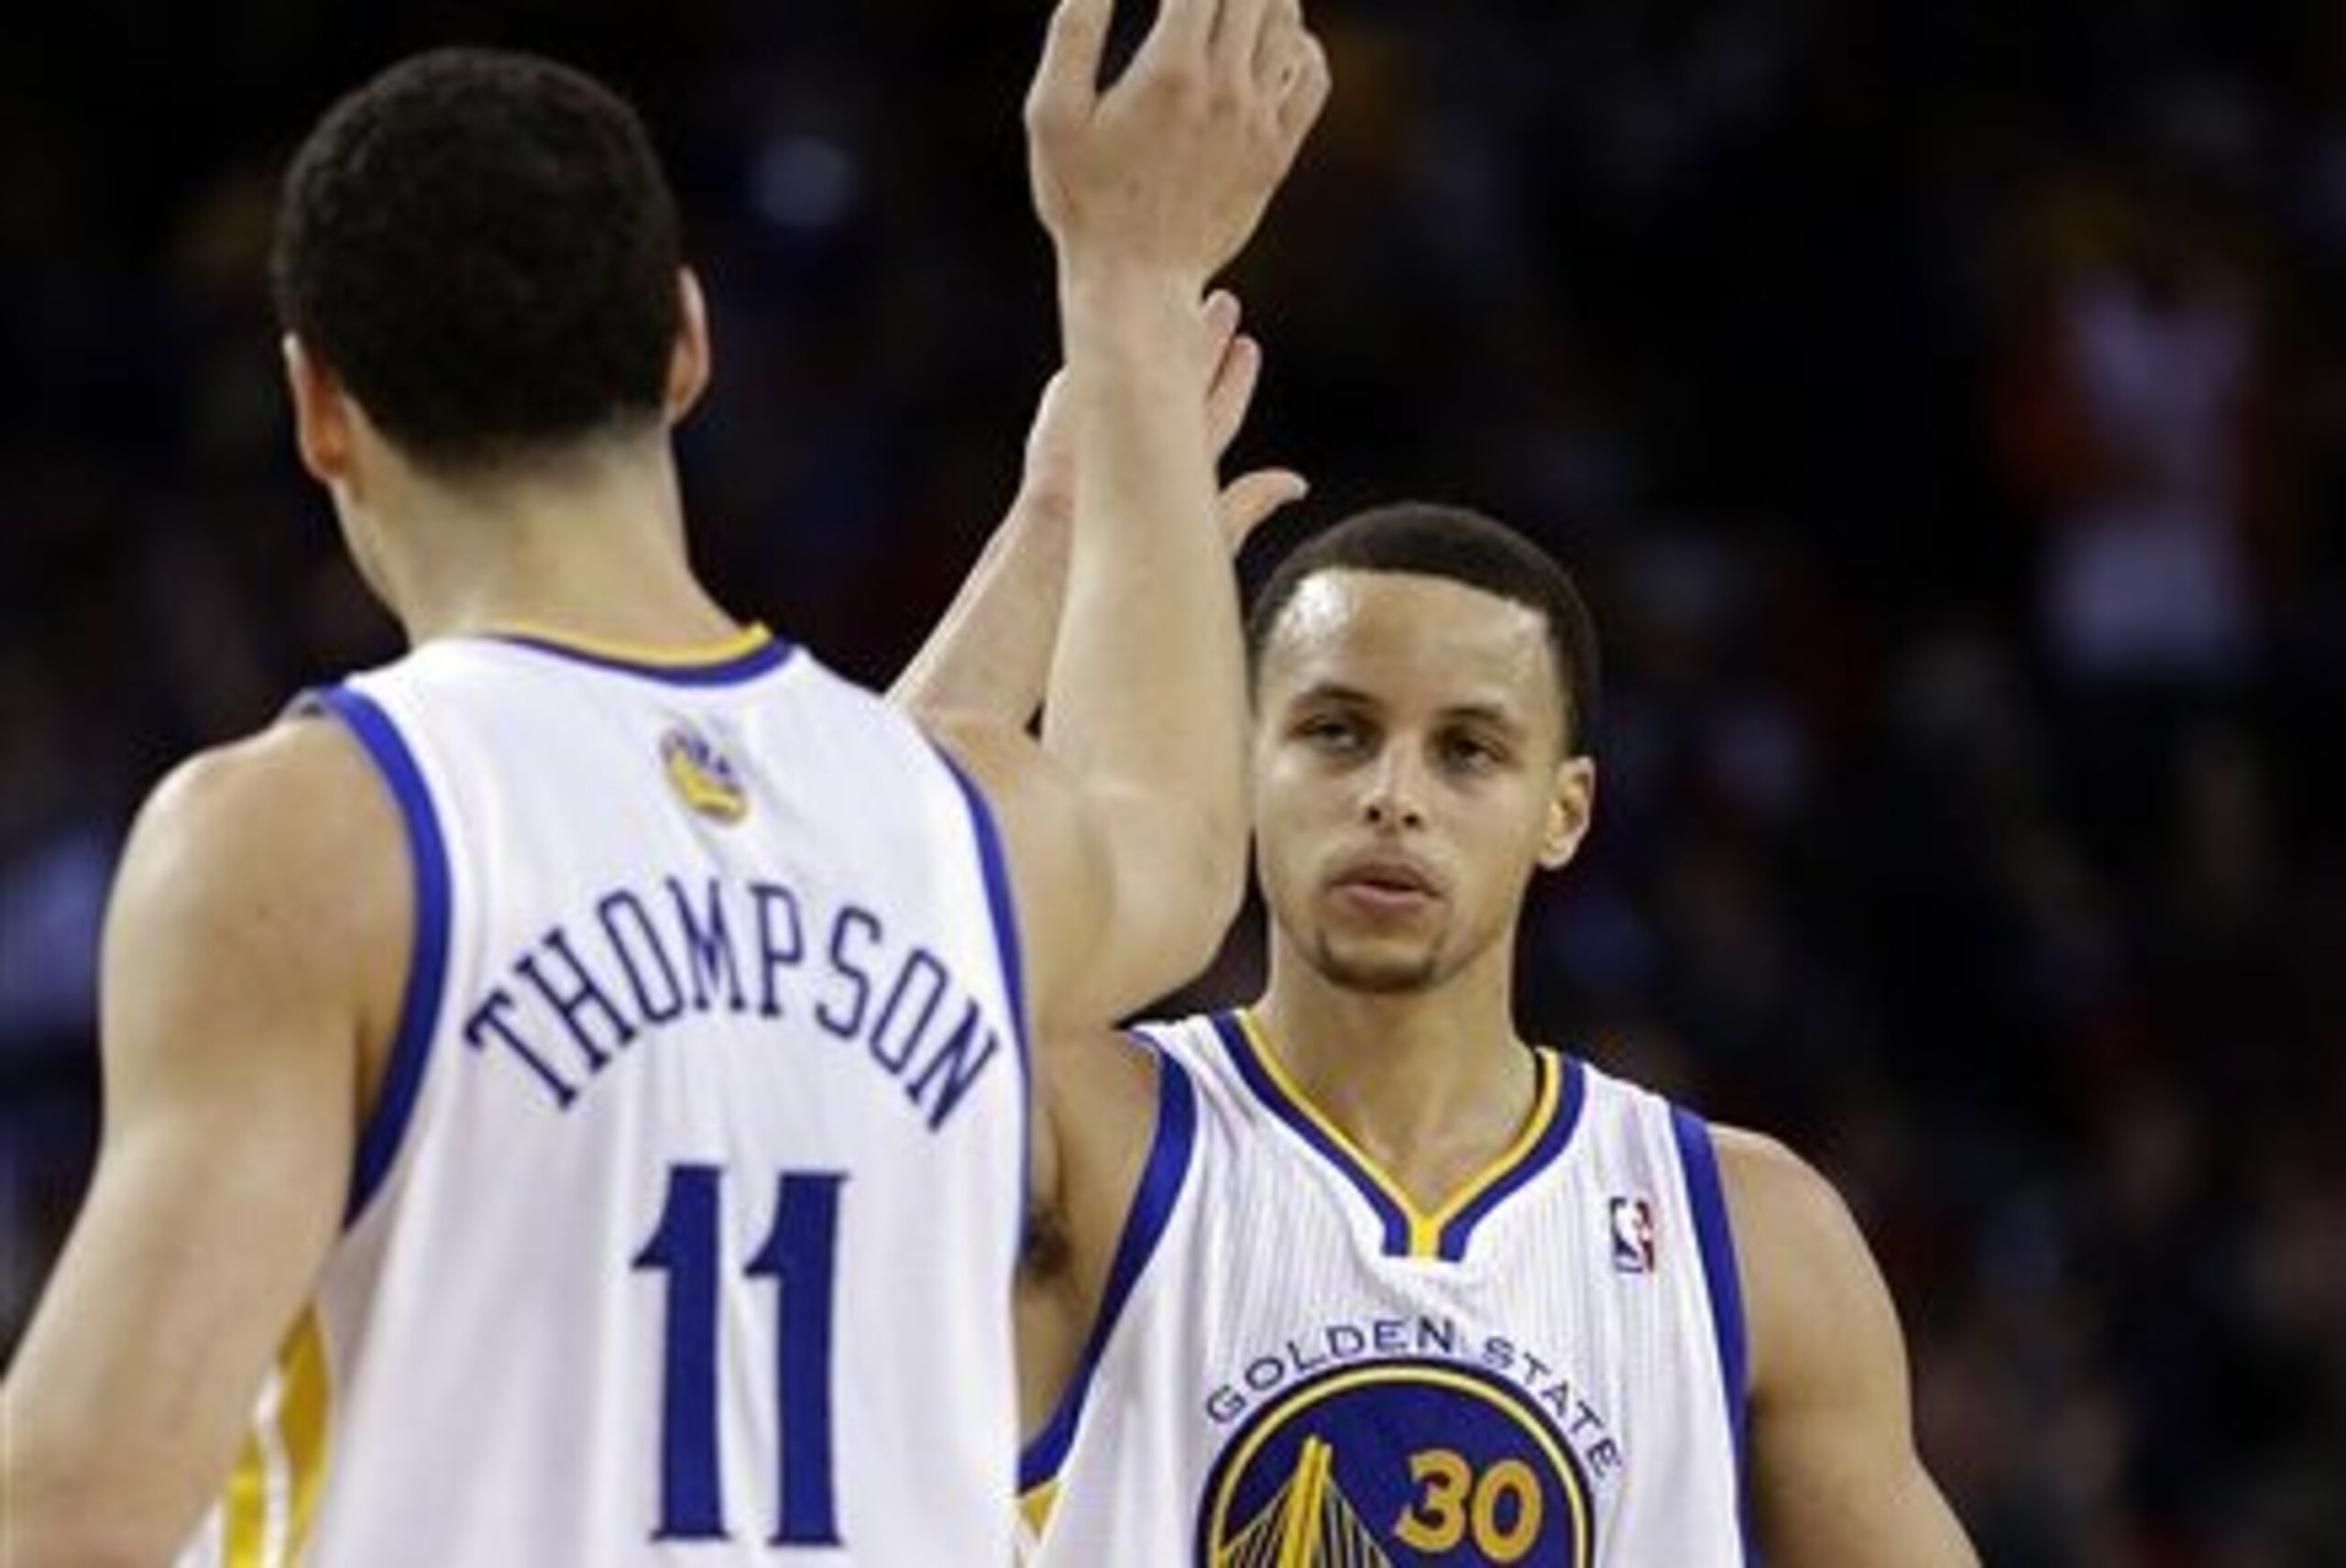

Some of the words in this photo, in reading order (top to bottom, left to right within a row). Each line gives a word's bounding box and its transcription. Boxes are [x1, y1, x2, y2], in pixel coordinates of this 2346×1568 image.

[462, 875, 1000, 1132] THOMPSON
[630, 1163, 850, 1548] 11
[1205, 1316, 1454, 1425] GOLDEN
[1481, 1336, 1622, 1478] STATE
[1394, 1448, 1543, 1563] 30
